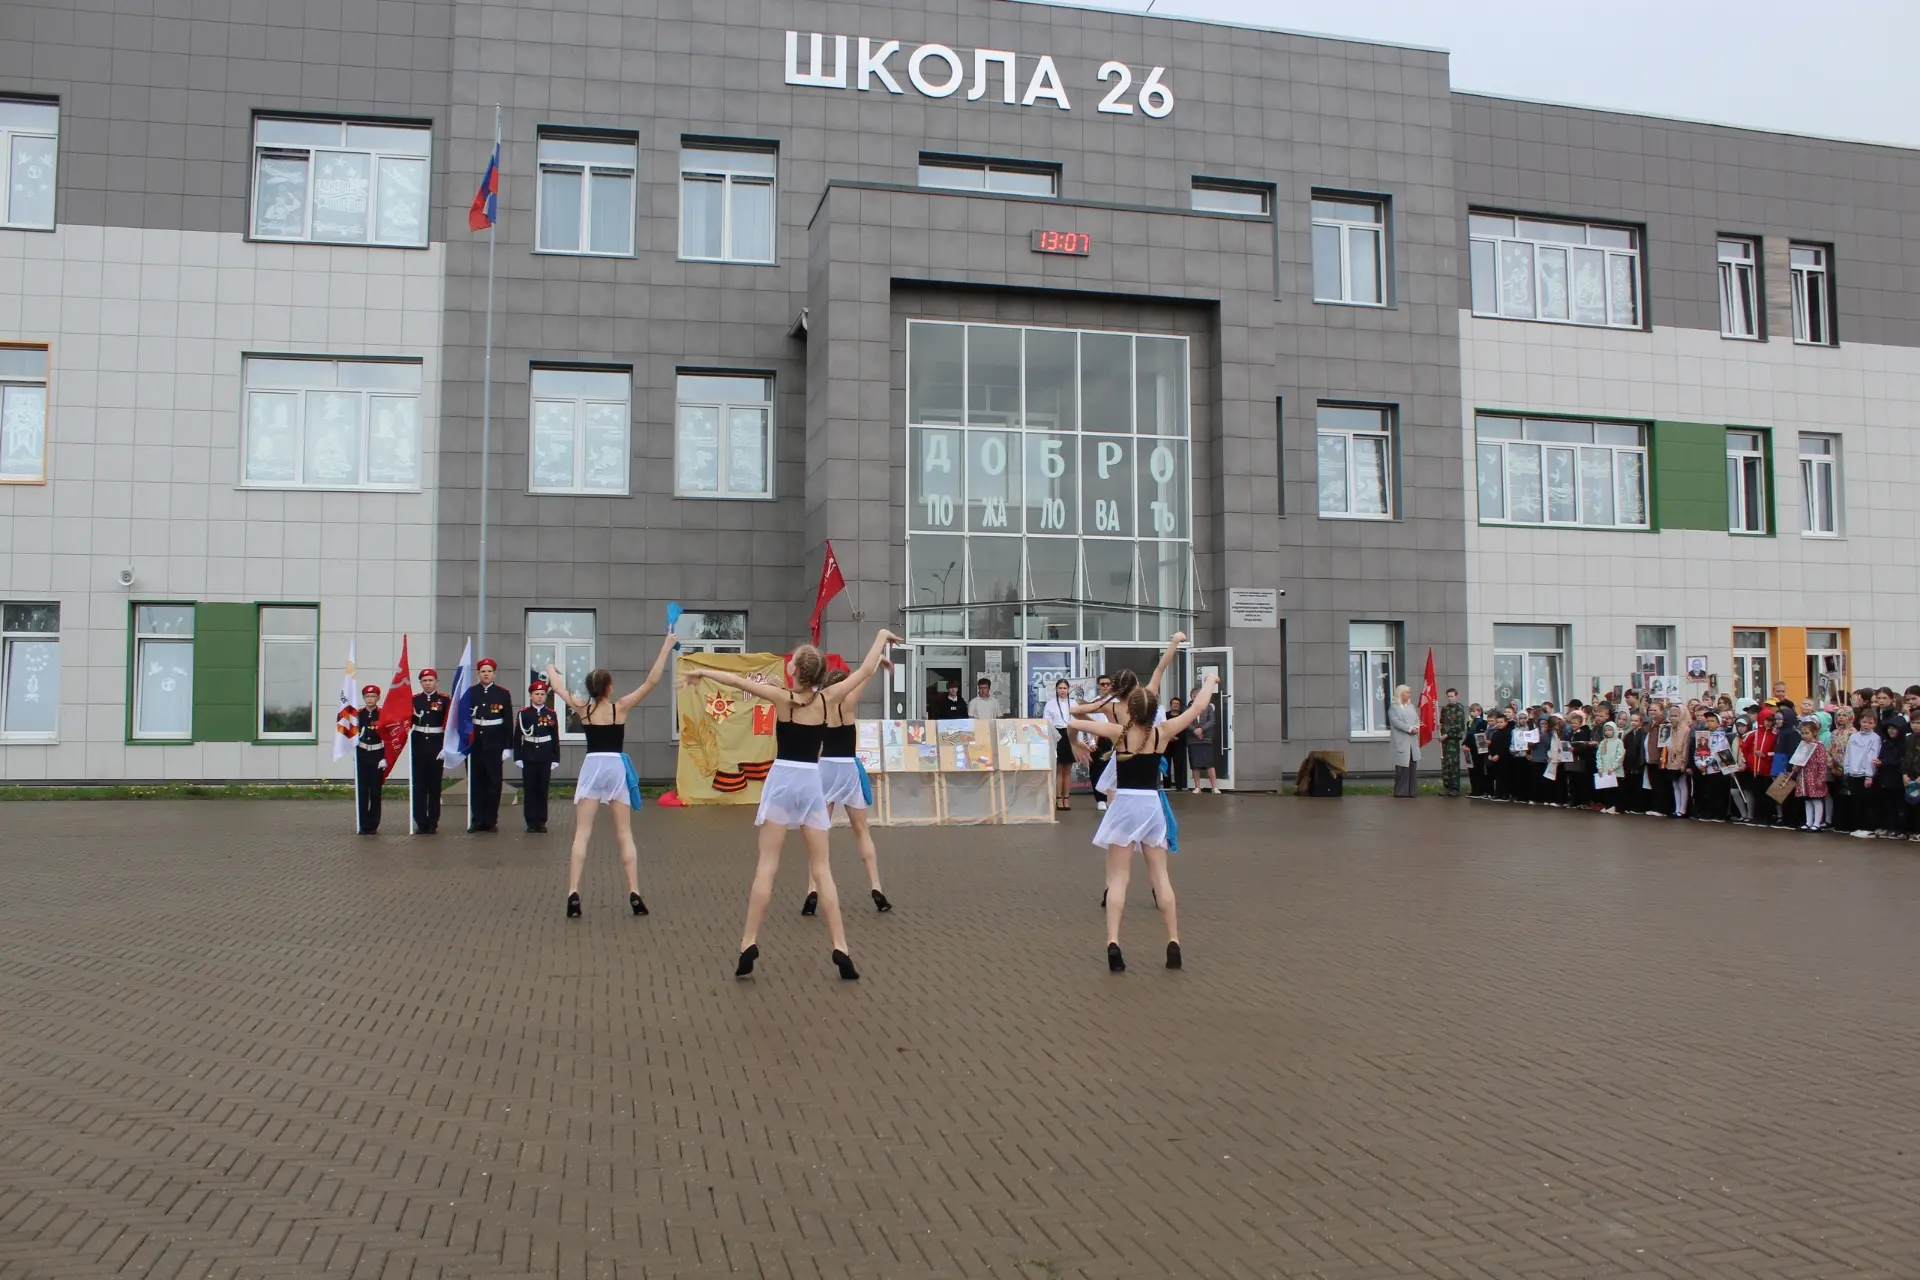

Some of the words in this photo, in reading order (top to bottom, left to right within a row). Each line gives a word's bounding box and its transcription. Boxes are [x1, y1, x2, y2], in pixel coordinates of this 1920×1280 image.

[785, 30, 1071, 111] ШКОЛА
[1097, 61, 1175, 119] 26
[1040, 231, 1090, 252] 13:07
[926, 434, 1175, 484] ДОБРО
